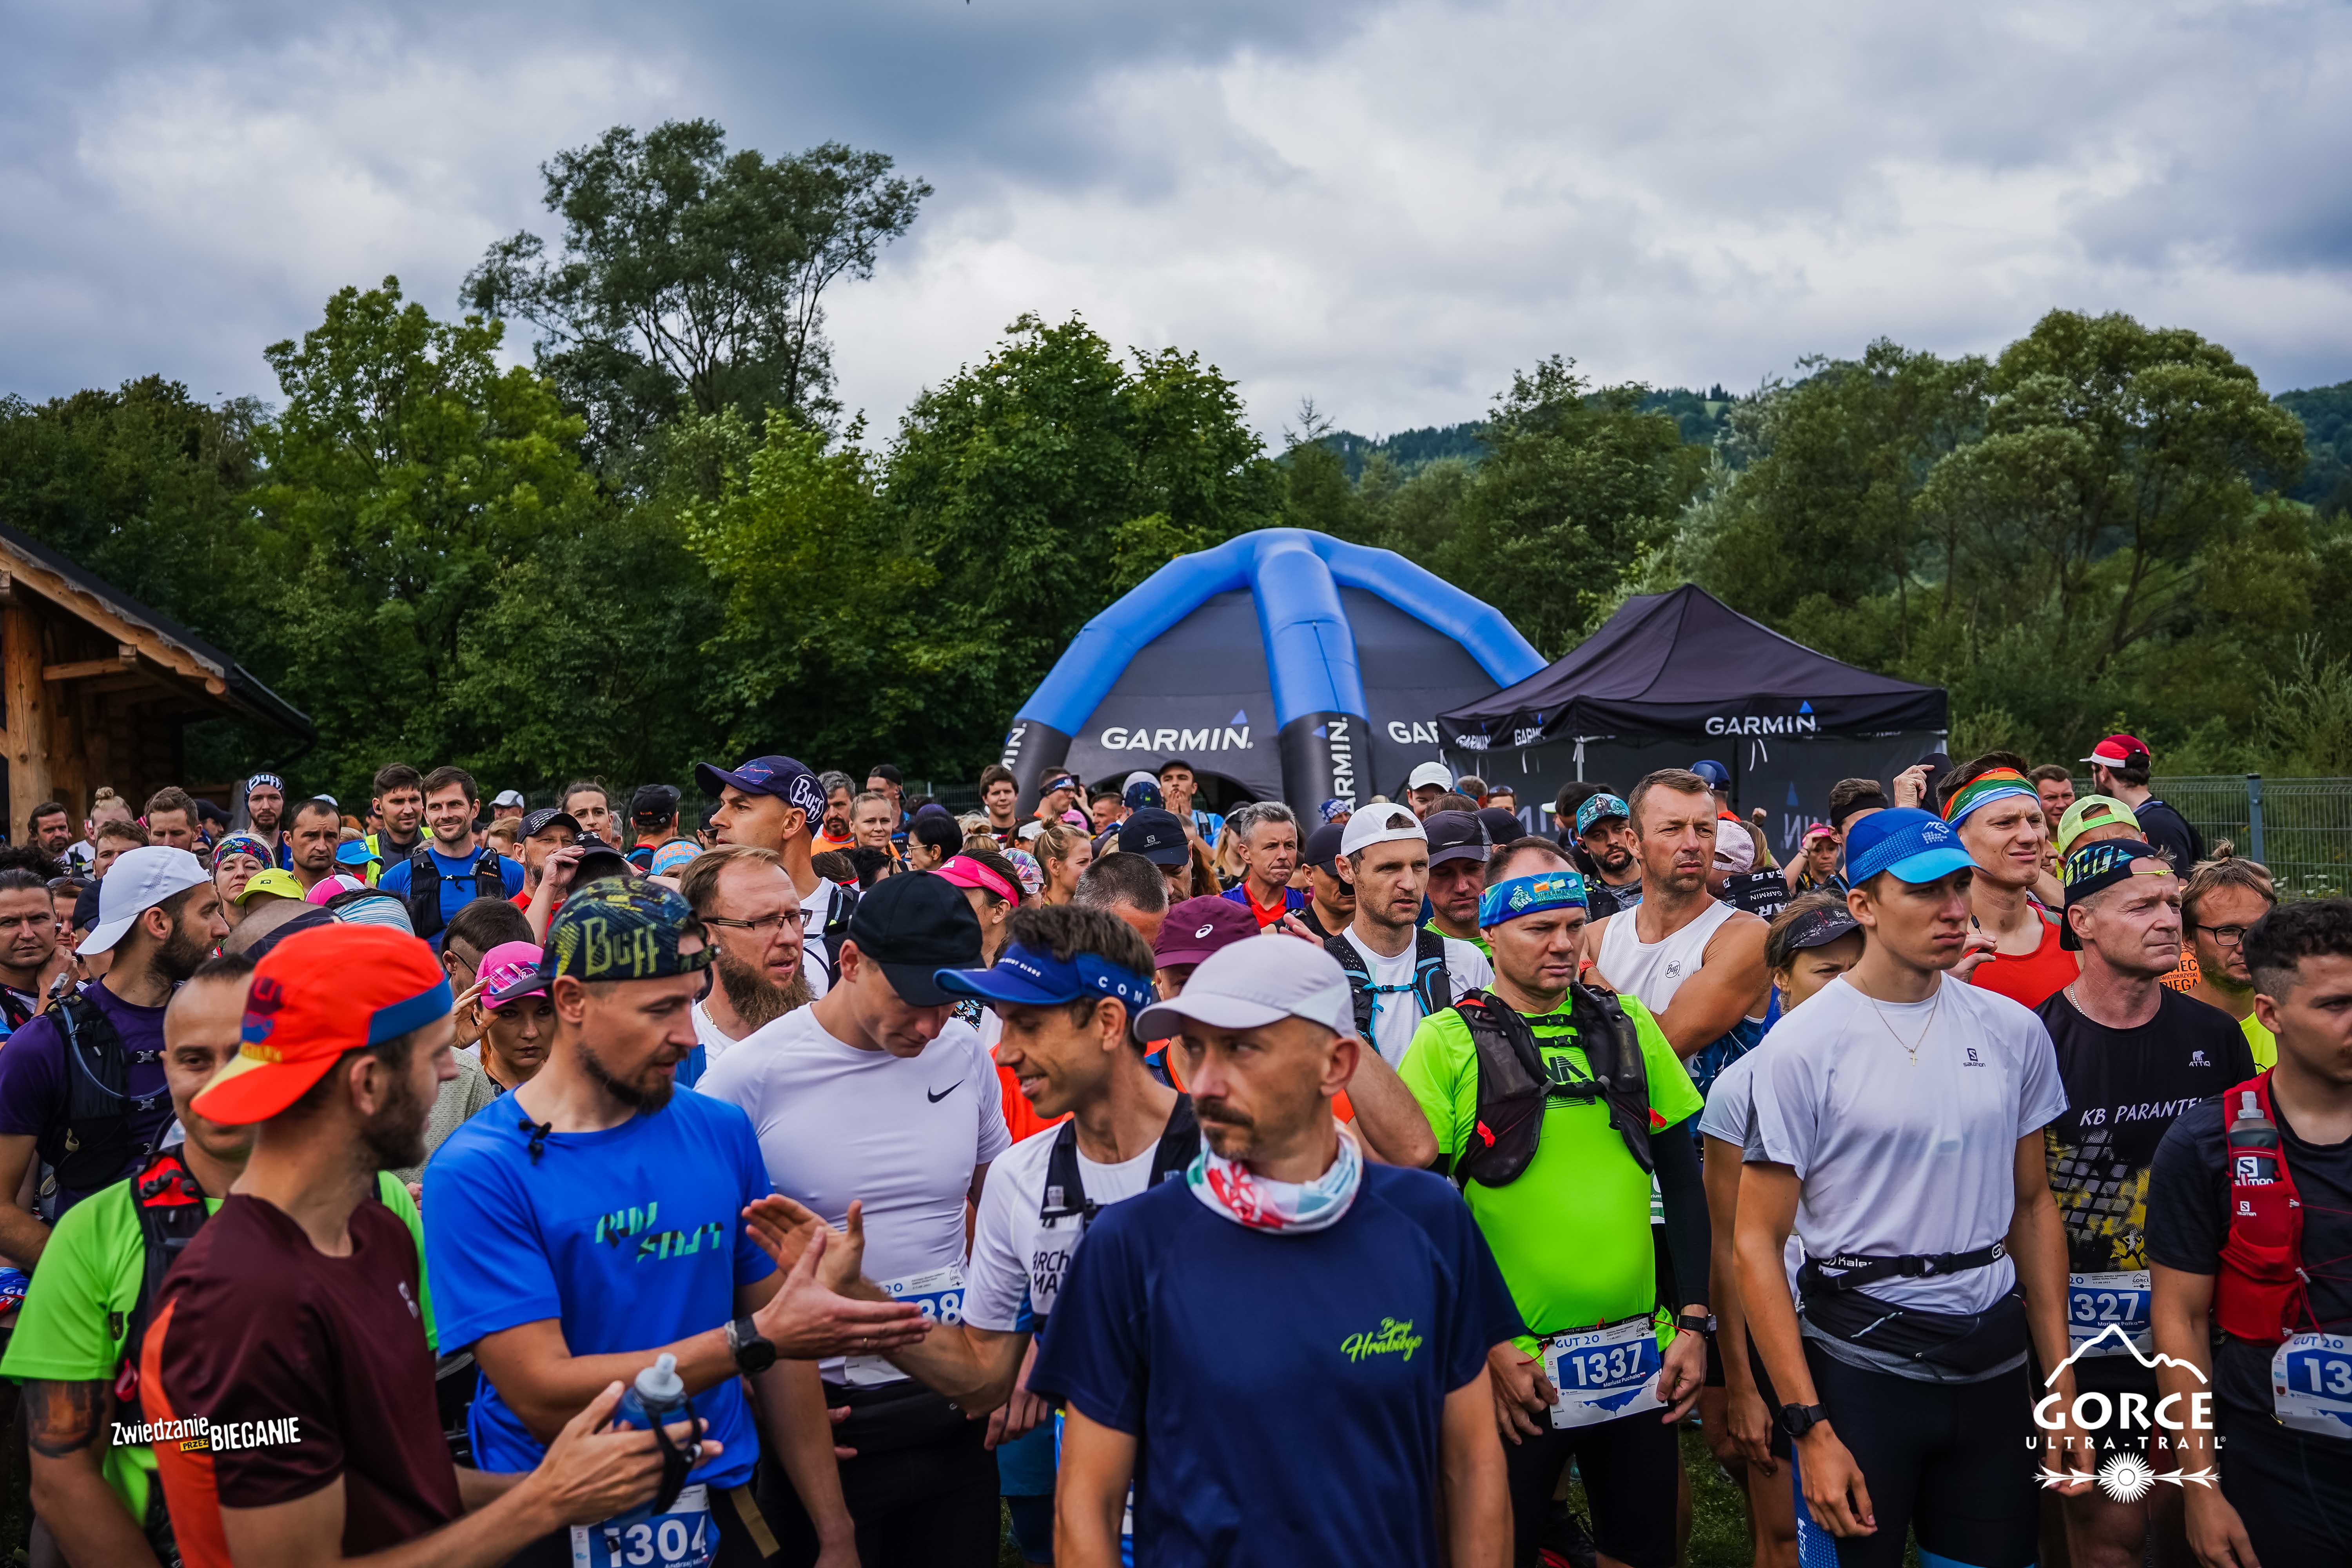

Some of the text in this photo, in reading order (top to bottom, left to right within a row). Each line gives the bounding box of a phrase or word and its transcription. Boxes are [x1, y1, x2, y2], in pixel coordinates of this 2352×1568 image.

[1705, 716, 1816, 735] GARMIN
[1100, 726, 1249, 751] GARMIN
[1750, 891, 1782, 901] GARMIN
[2080, 1098, 2201, 1126] KB PARANTE
[1555, 1338, 1579, 1348] GUT
[1584, 1335, 1599, 1345] 20
[2294, 1336, 2318, 1346] GUT
[1573, 1342, 1642, 1386] 1337
[1603, 1373, 1641, 1388] Mariusz Puchała
[604, 1514, 706, 1568] 1304
